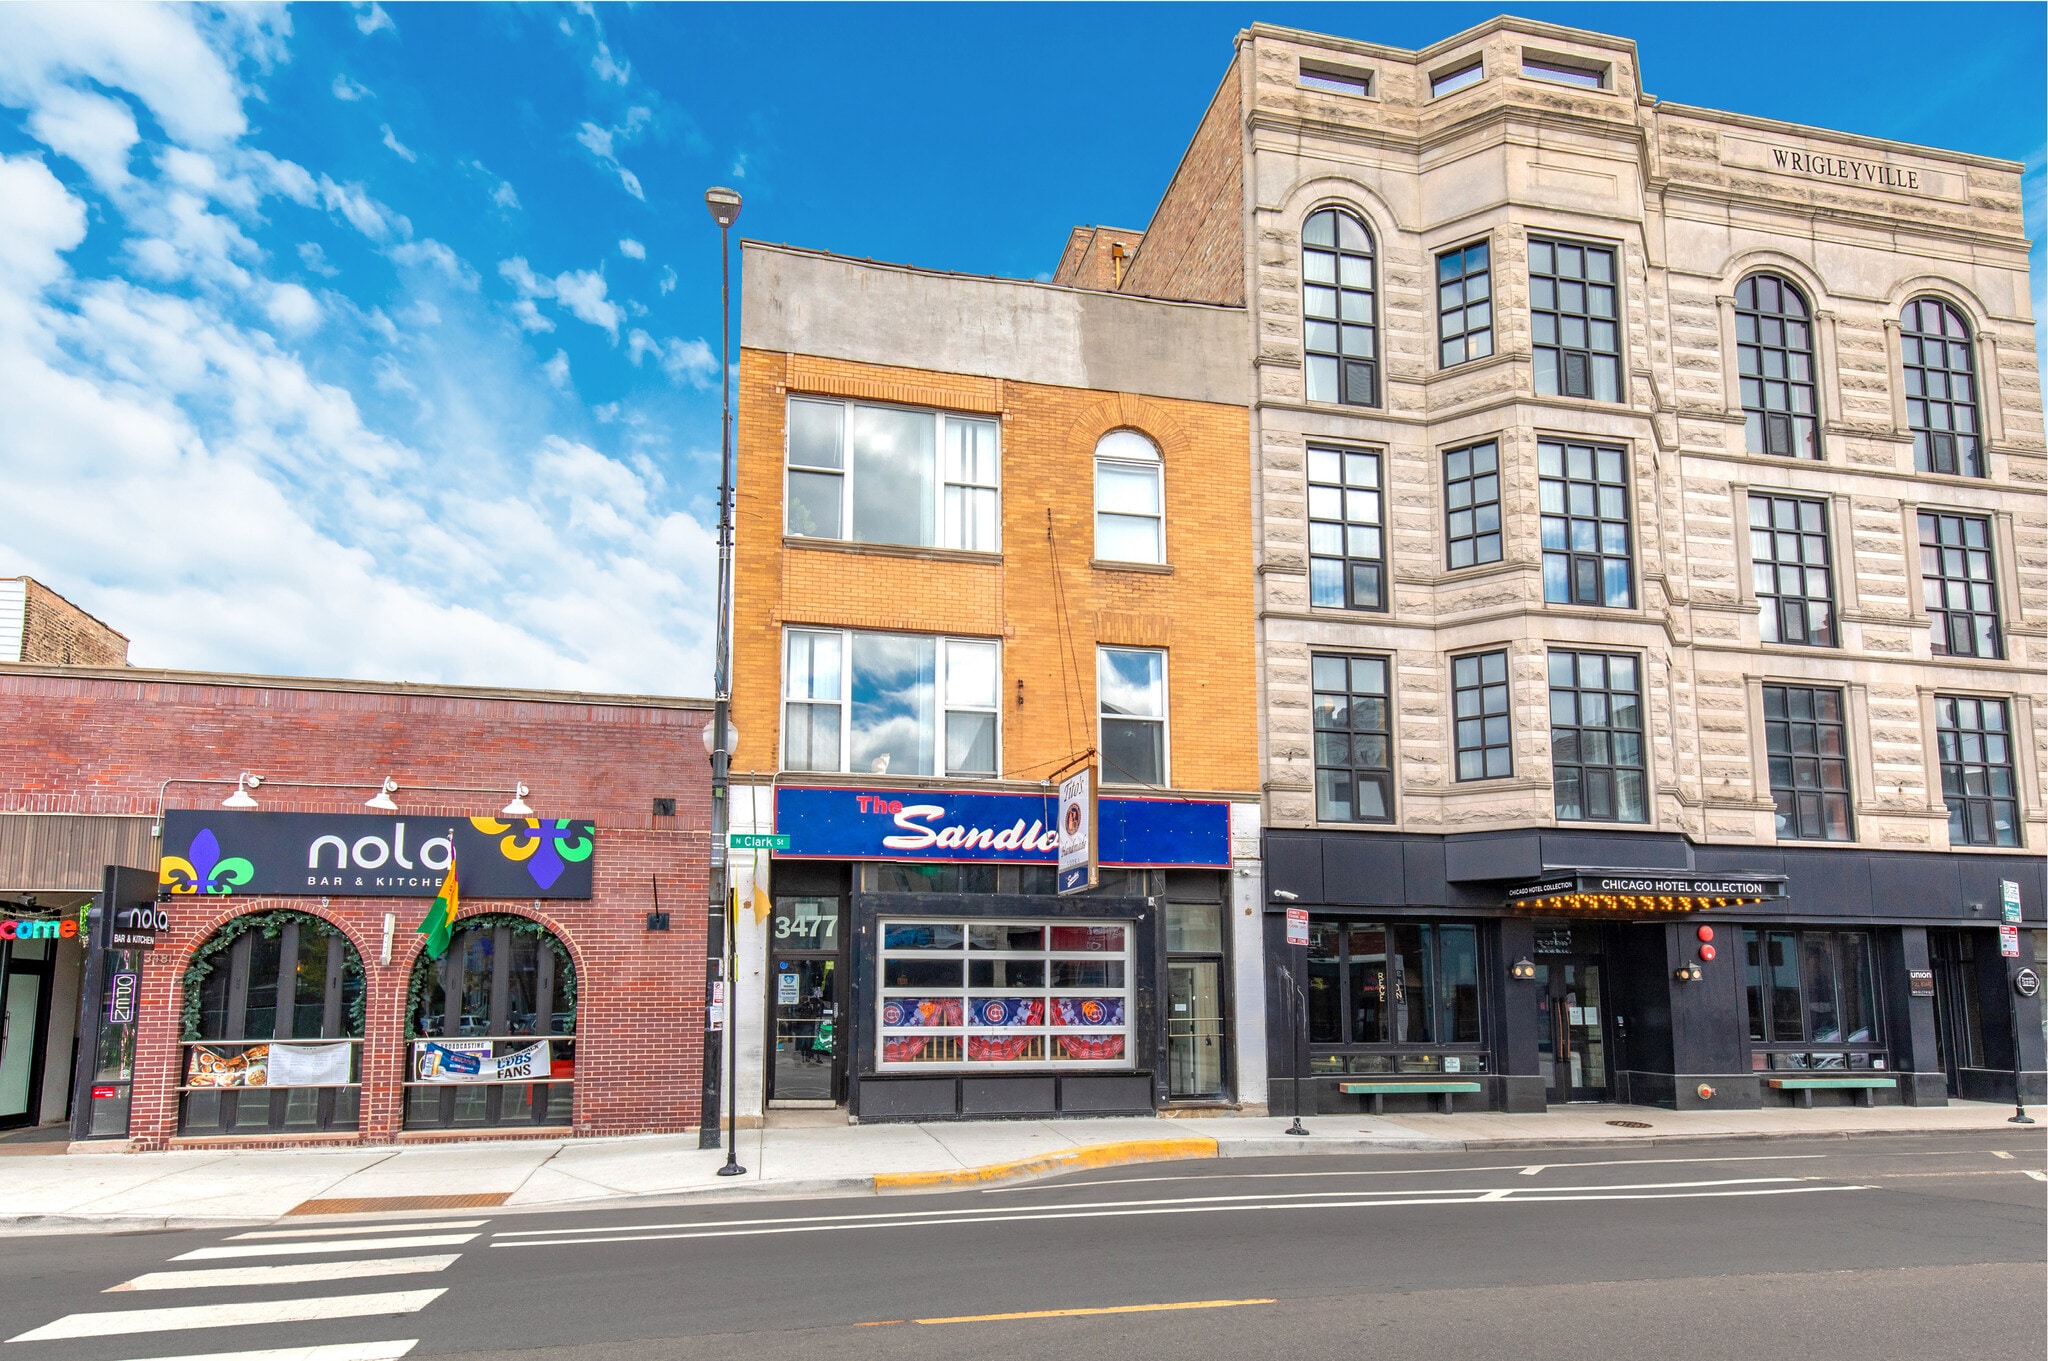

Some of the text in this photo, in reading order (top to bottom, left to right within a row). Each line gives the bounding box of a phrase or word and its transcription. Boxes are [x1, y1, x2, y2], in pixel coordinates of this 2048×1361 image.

[1772, 149, 1919, 189] WRIGLEYVILLE
[1064, 776, 1084, 802] Tito's
[856, 795, 903, 814] The
[883, 805, 1059, 851] Sandlo
[308, 822, 456, 870] nola
[744, 836, 773, 847] Clark
[307, 876, 443, 887] BAR & KITCHE
[1509, 881, 1573, 896] CHICAGO HOTEL COLLECTION
[1601, 879, 1762, 893] CHICAGO HOTEL COLLECTION
[130, 901, 169, 930] nola
[0, 919, 78, 940] come
[775, 915, 838, 939] 3477
[113, 933, 125, 943] BAR
[132, 933, 155, 945] KITCHEN
[114, 976, 133, 1020] OPEN
[497, 1052, 532, 1069] CUBS
[497, 1063, 532, 1079] FANS
